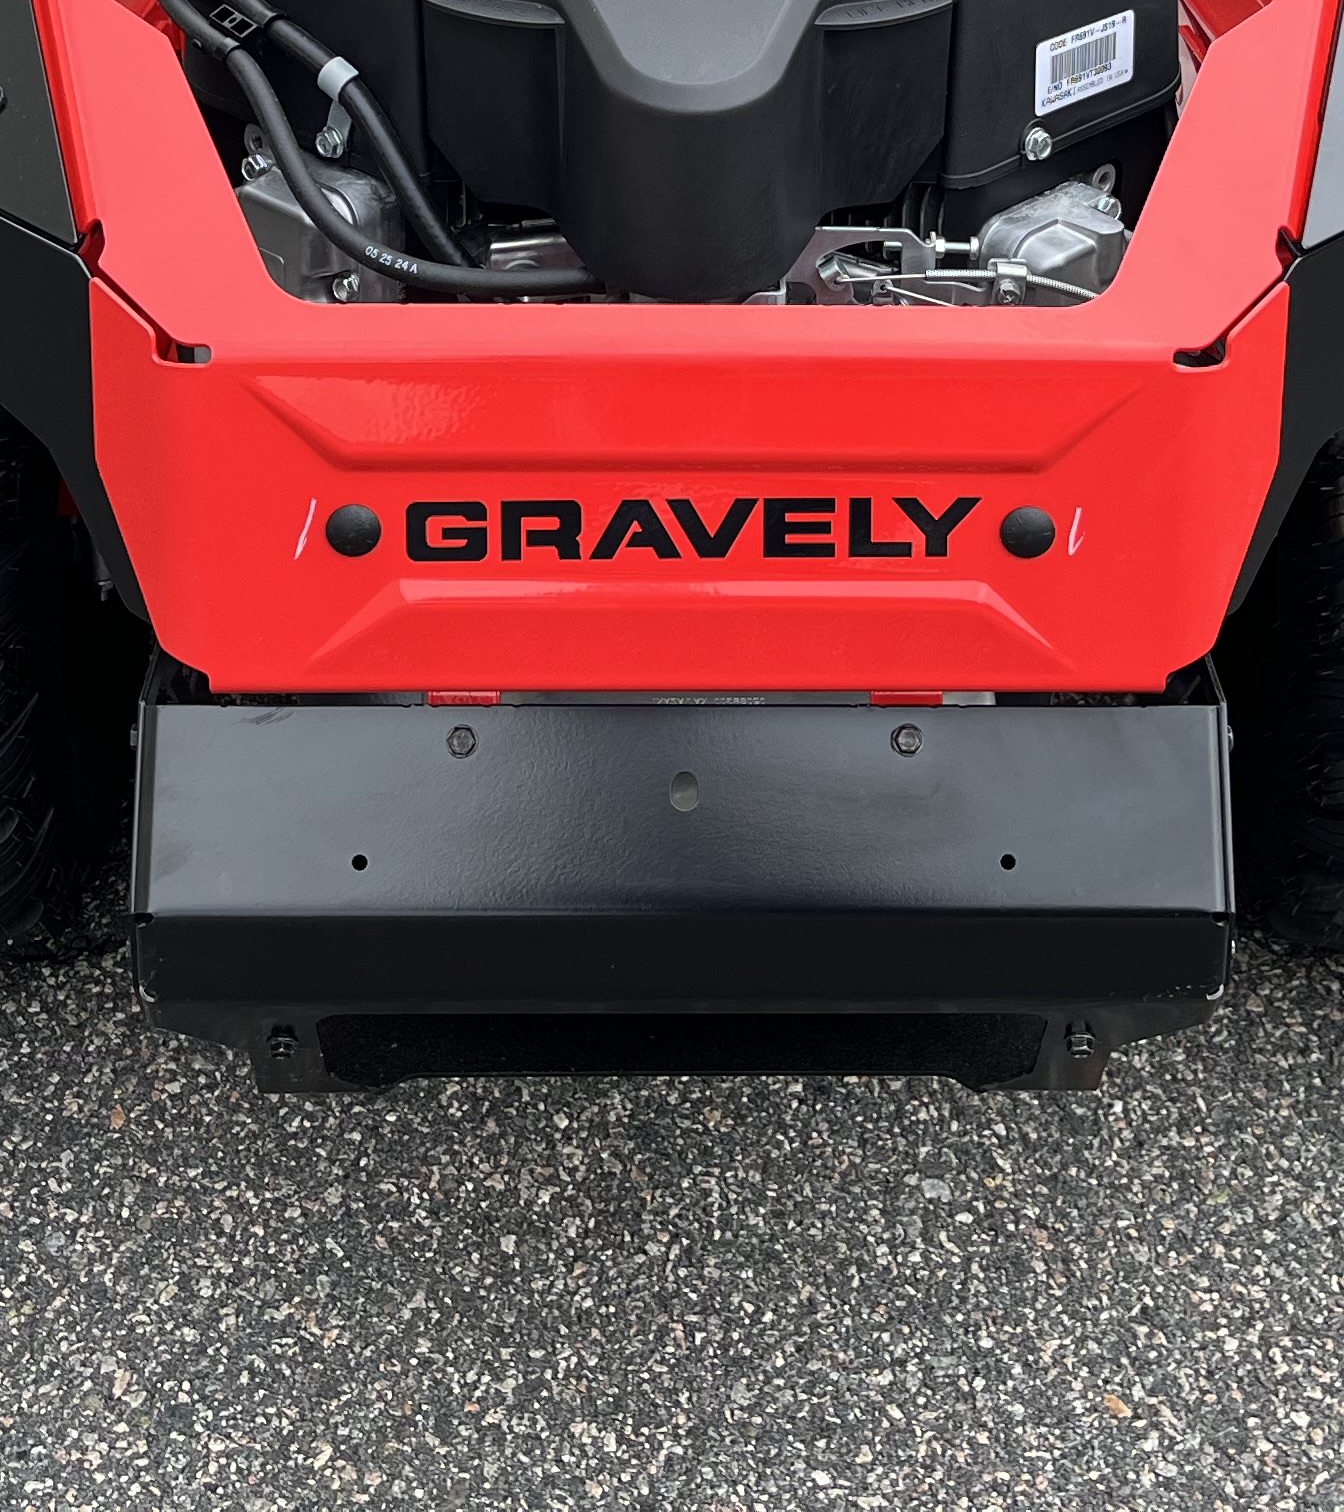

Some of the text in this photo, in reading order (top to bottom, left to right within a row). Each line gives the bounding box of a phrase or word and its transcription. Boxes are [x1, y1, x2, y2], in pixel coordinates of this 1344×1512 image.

[1041, 86, 1077, 108] KAWASAKI
[379, 252, 393, 266] 25
[394, 258, 409, 271] 24
[409, 263, 418, 274] A
[405, 496, 983, 563] GRAVELY
